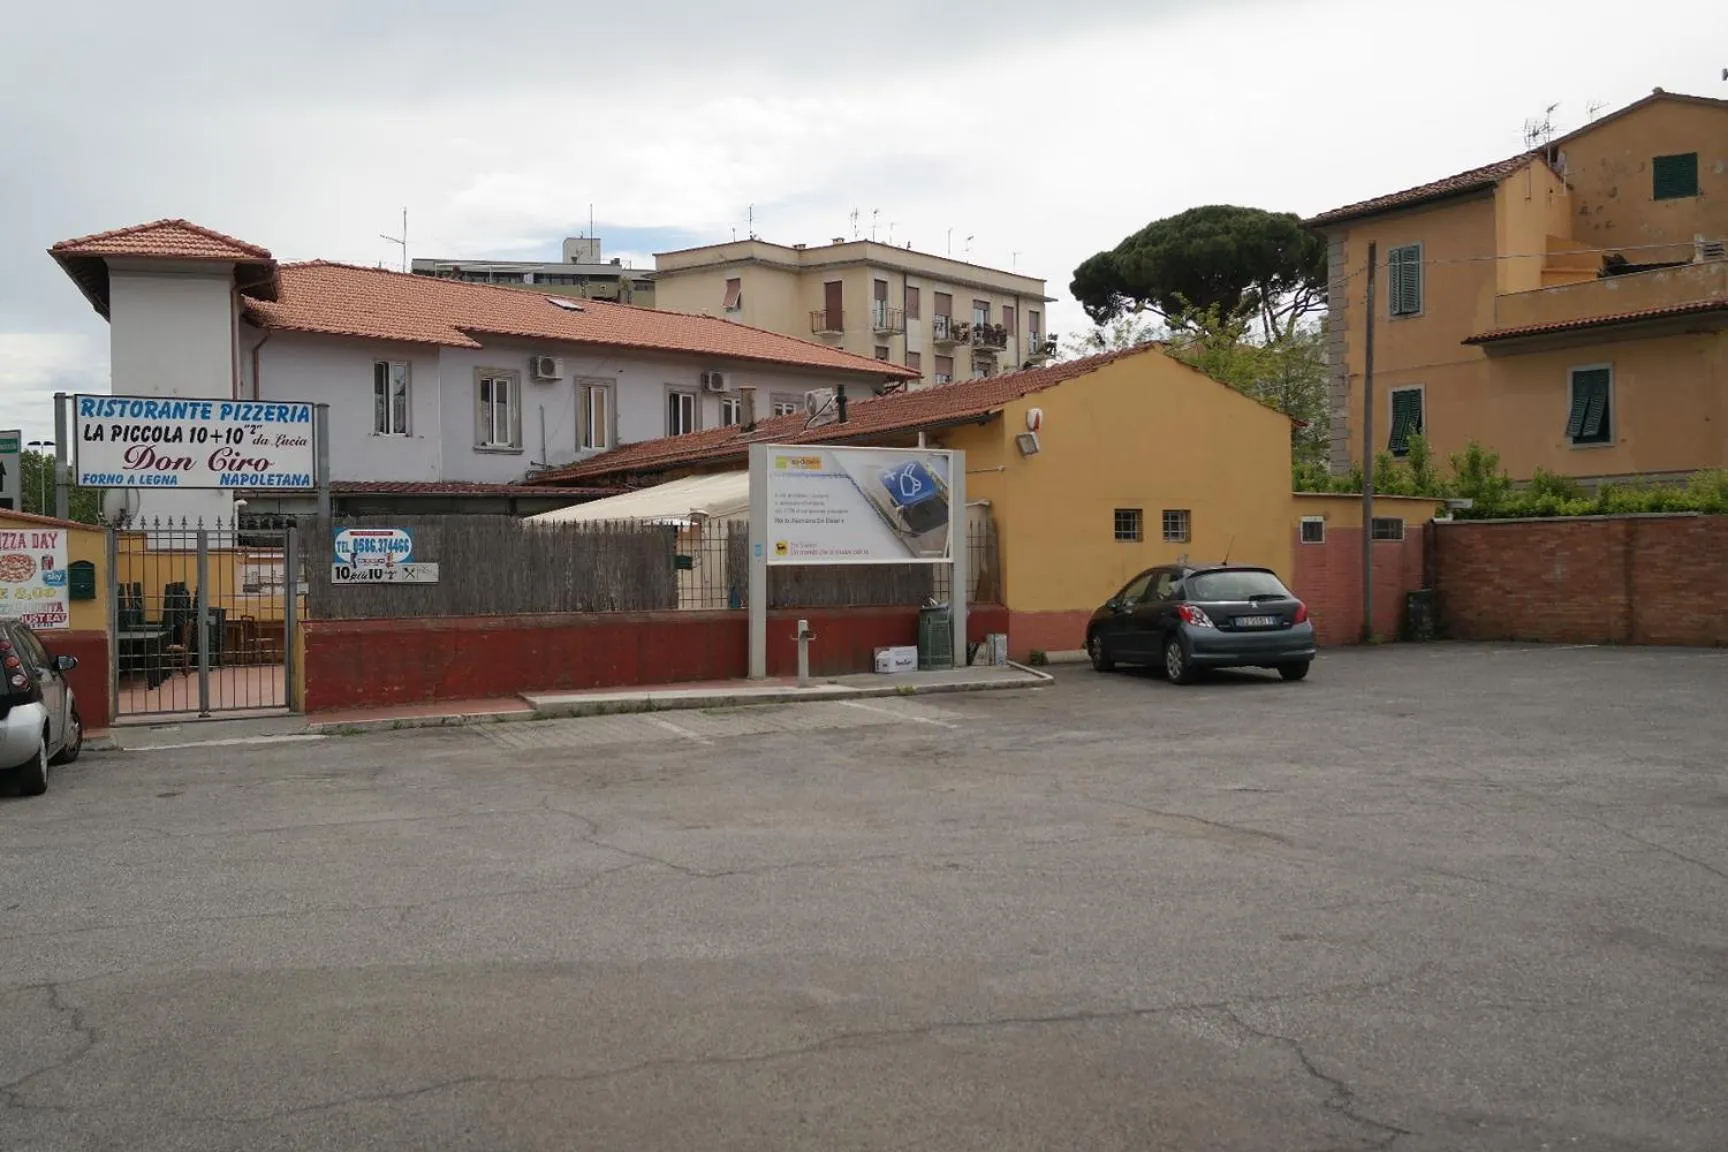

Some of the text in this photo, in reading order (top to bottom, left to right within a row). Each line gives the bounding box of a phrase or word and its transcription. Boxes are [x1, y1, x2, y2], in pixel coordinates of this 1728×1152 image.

[81, 398, 310, 423] RISTORANTE PIZZERIA
[84, 424, 104, 441] LA
[111, 424, 183, 443] PICCOLA
[189, 426, 244, 444] 10+10
[252, 434, 269, 446] da
[122, 444, 275, 472] Don Ciro
[82, 473, 310, 486] FORNO A LEGNA NAPOLETANA
[32, 532, 58, 549] DAY
